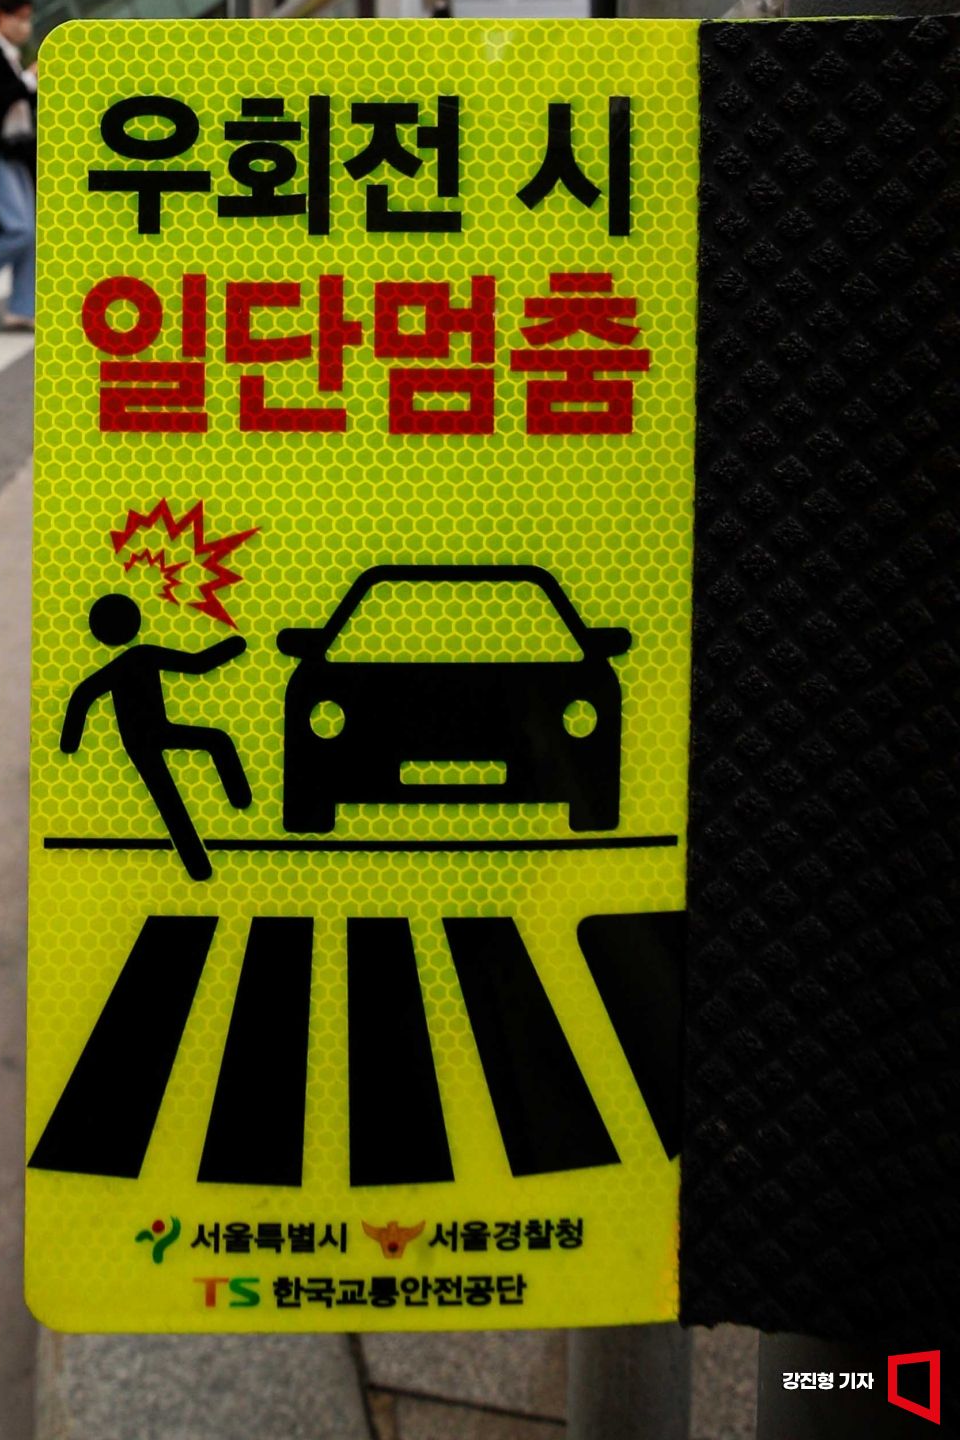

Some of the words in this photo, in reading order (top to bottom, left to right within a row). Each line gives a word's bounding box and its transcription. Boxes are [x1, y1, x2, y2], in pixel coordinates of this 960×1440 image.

[88, 95, 462, 235] 우회전
[516, 96, 630, 237] 시
[81, 272, 650, 436] 일단멈춤
[190, 1221, 348, 1254] 서울특별시
[428, 1218, 584, 1252] 서울경찰청
[193, 1276, 261, 1308] TS
[272, 1274, 527, 1308] 한국교통안전공단
